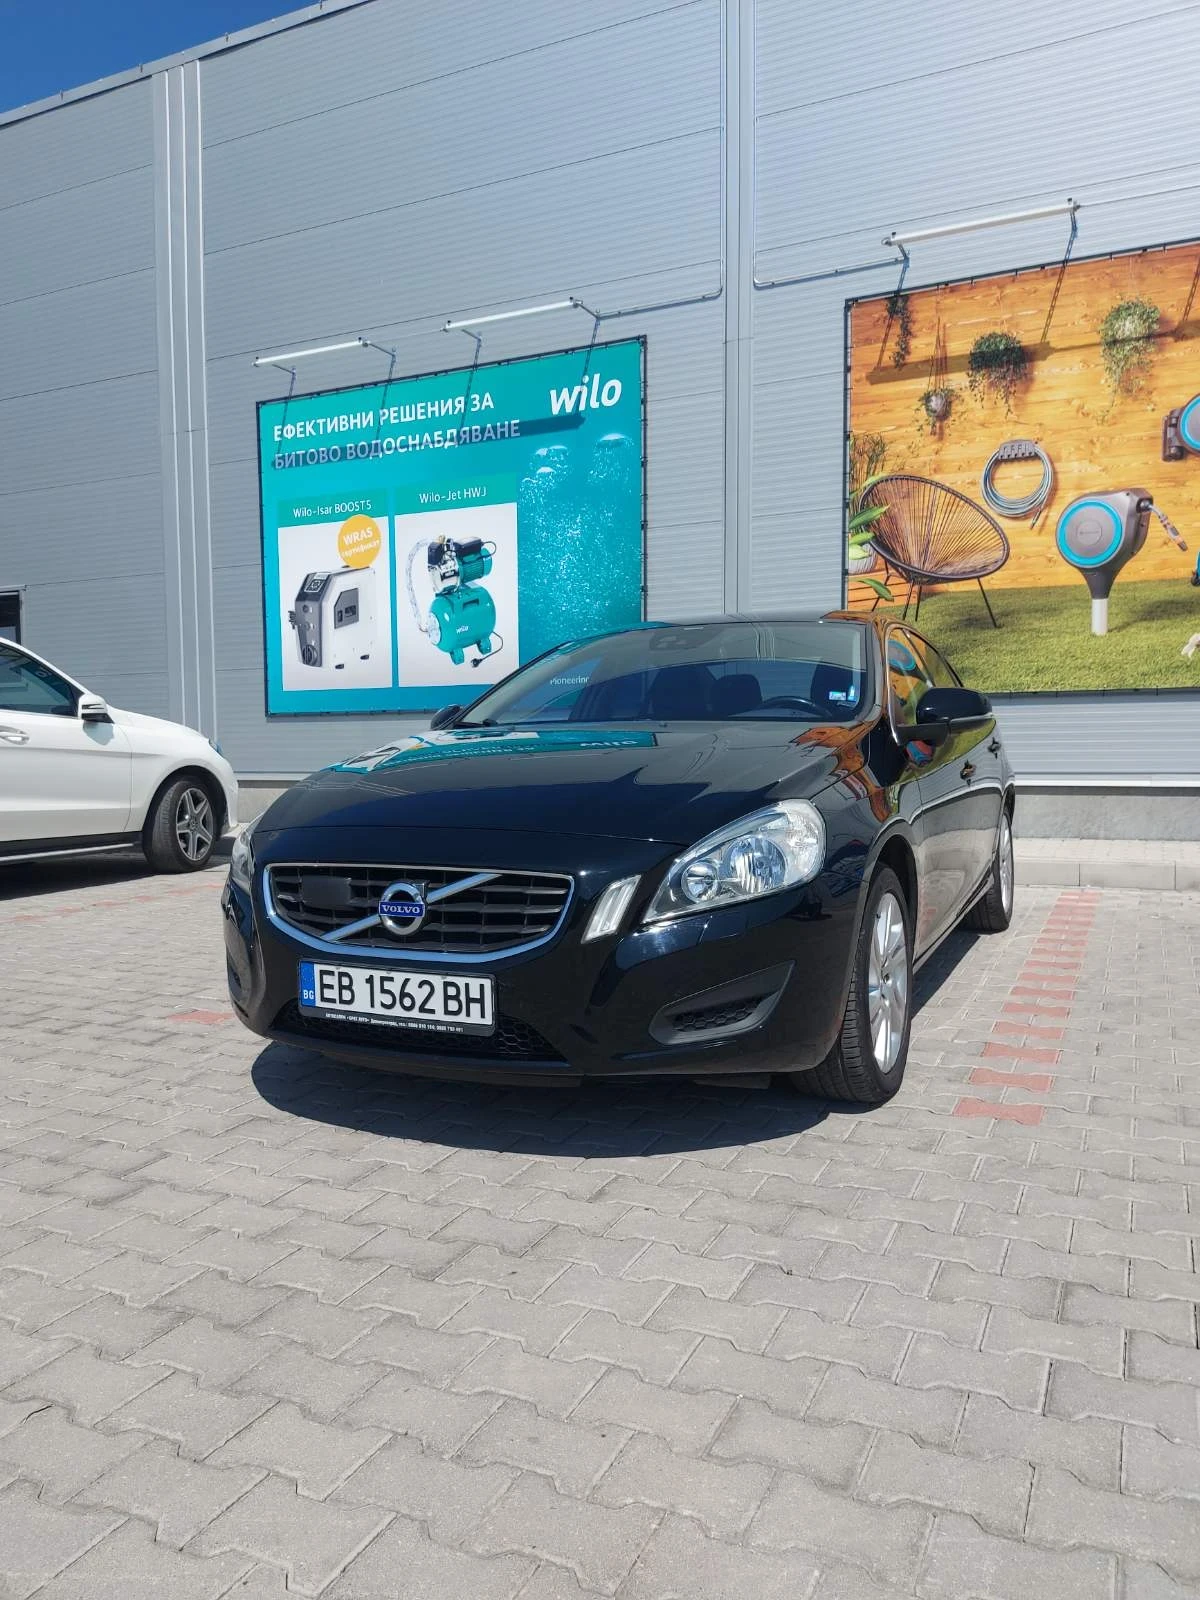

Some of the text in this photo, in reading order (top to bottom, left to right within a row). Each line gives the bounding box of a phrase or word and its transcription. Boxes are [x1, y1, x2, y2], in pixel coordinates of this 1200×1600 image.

[550, 373, 622, 415] wilo
[273, 392, 494, 442] ЕФЕКТИВНИ РЕШЕНИЯ ЗА
[275, 419, 520, 469] БИТОВО ВОДОСНАБДЯВАНЕ
[419, 486, 487, 504] Wilo-Jet HWJ
[293, 500, 372, 518] Wilo-Isar BOOST5
[343, 527, 373, 546] WRAS
[382, 904, 420, 914] VOLVO
[303, 989, 315, 1000] BG
[319, 969, 486, 1019] EB 1562 BH
